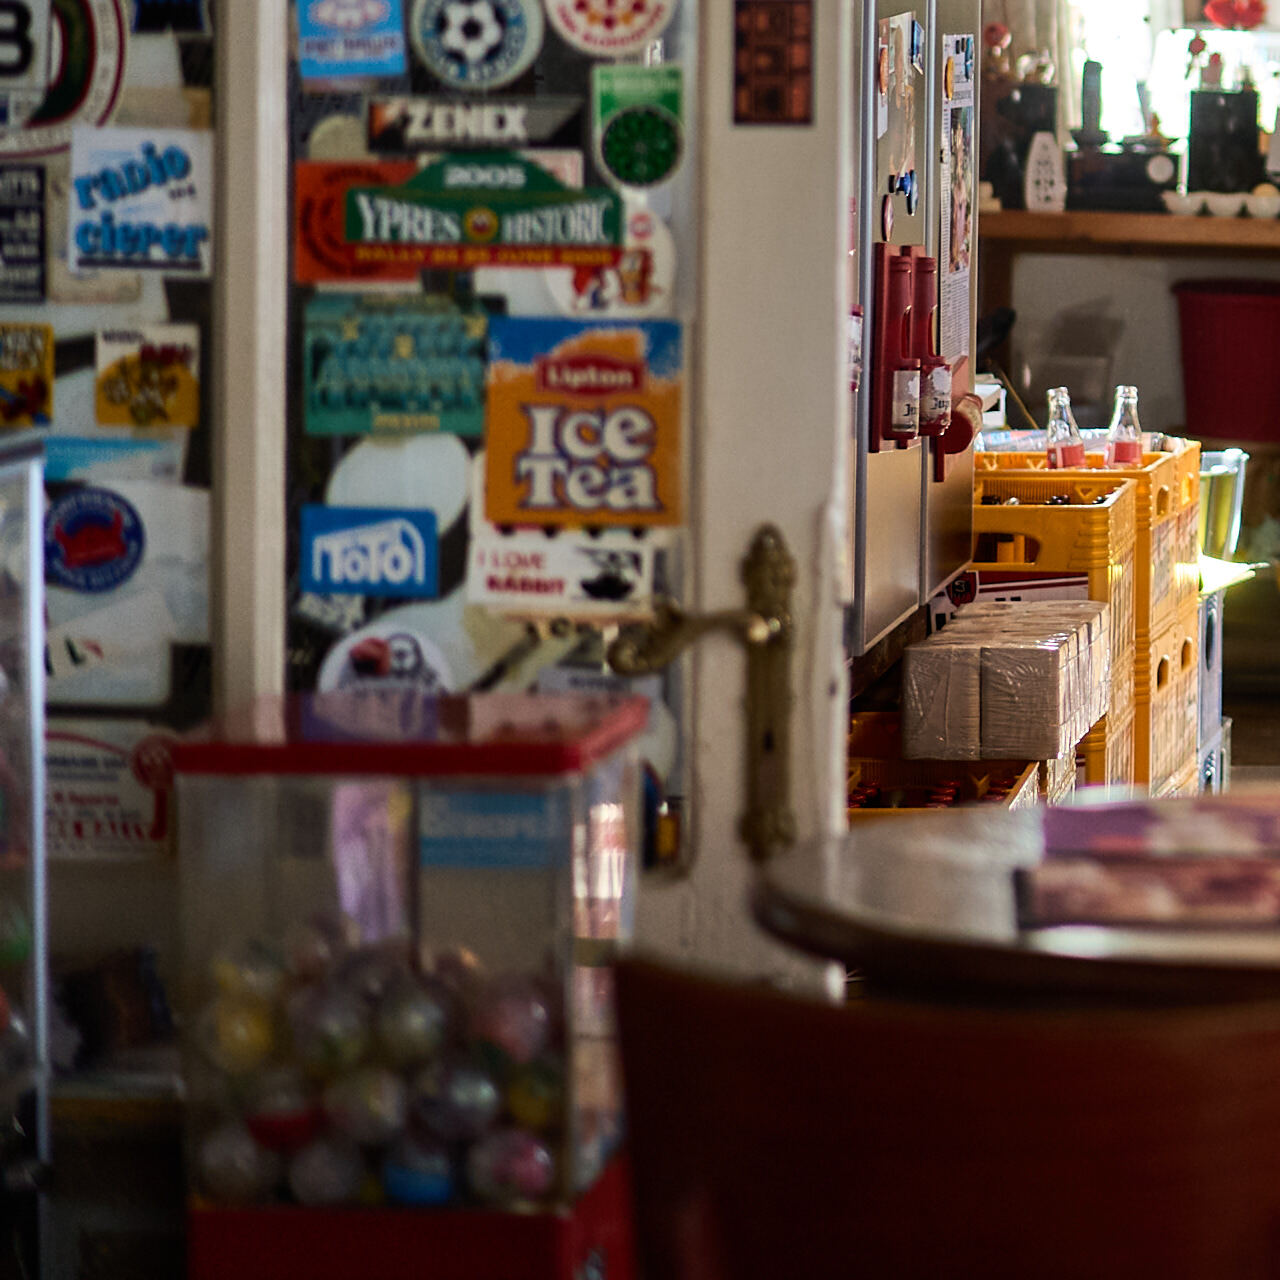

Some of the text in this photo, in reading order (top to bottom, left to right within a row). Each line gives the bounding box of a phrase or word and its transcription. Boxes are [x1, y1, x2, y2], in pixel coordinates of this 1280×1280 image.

[405, 101, 530, 143] ZENEX
[73, 139, 193, 210] radio
[355, 192, 616, 244] YPRES HISTORIC
[546, 364, 634, 388] Lipton
[524, 403, 655, 462] Ice
[517, 457, 664, 513] Tea
